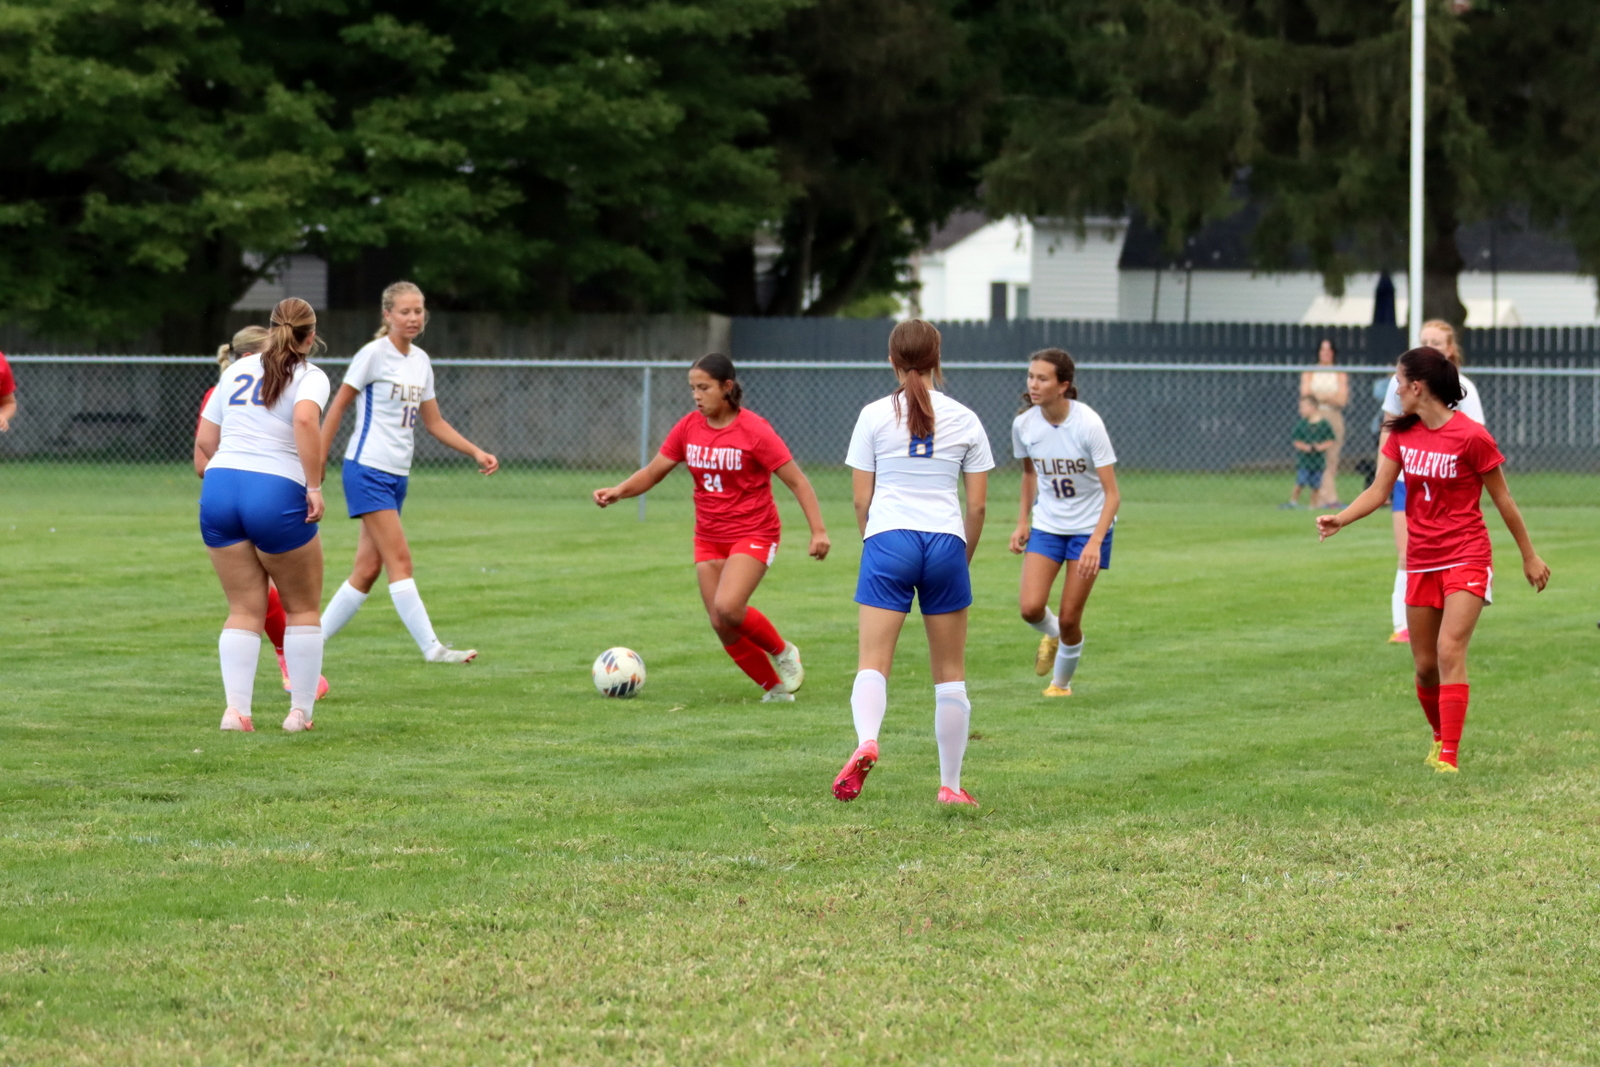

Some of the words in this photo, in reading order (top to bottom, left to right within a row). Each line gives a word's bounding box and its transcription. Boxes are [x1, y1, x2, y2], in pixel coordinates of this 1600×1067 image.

[686, 443, 743, 471] BELLEVUE
[1033, 457, 1087, 476] FLIERS
[703, 473, 723, 493] 24
[1051, 477, 1076, 499] 16
[1422, 481, 1431, 501] 1
